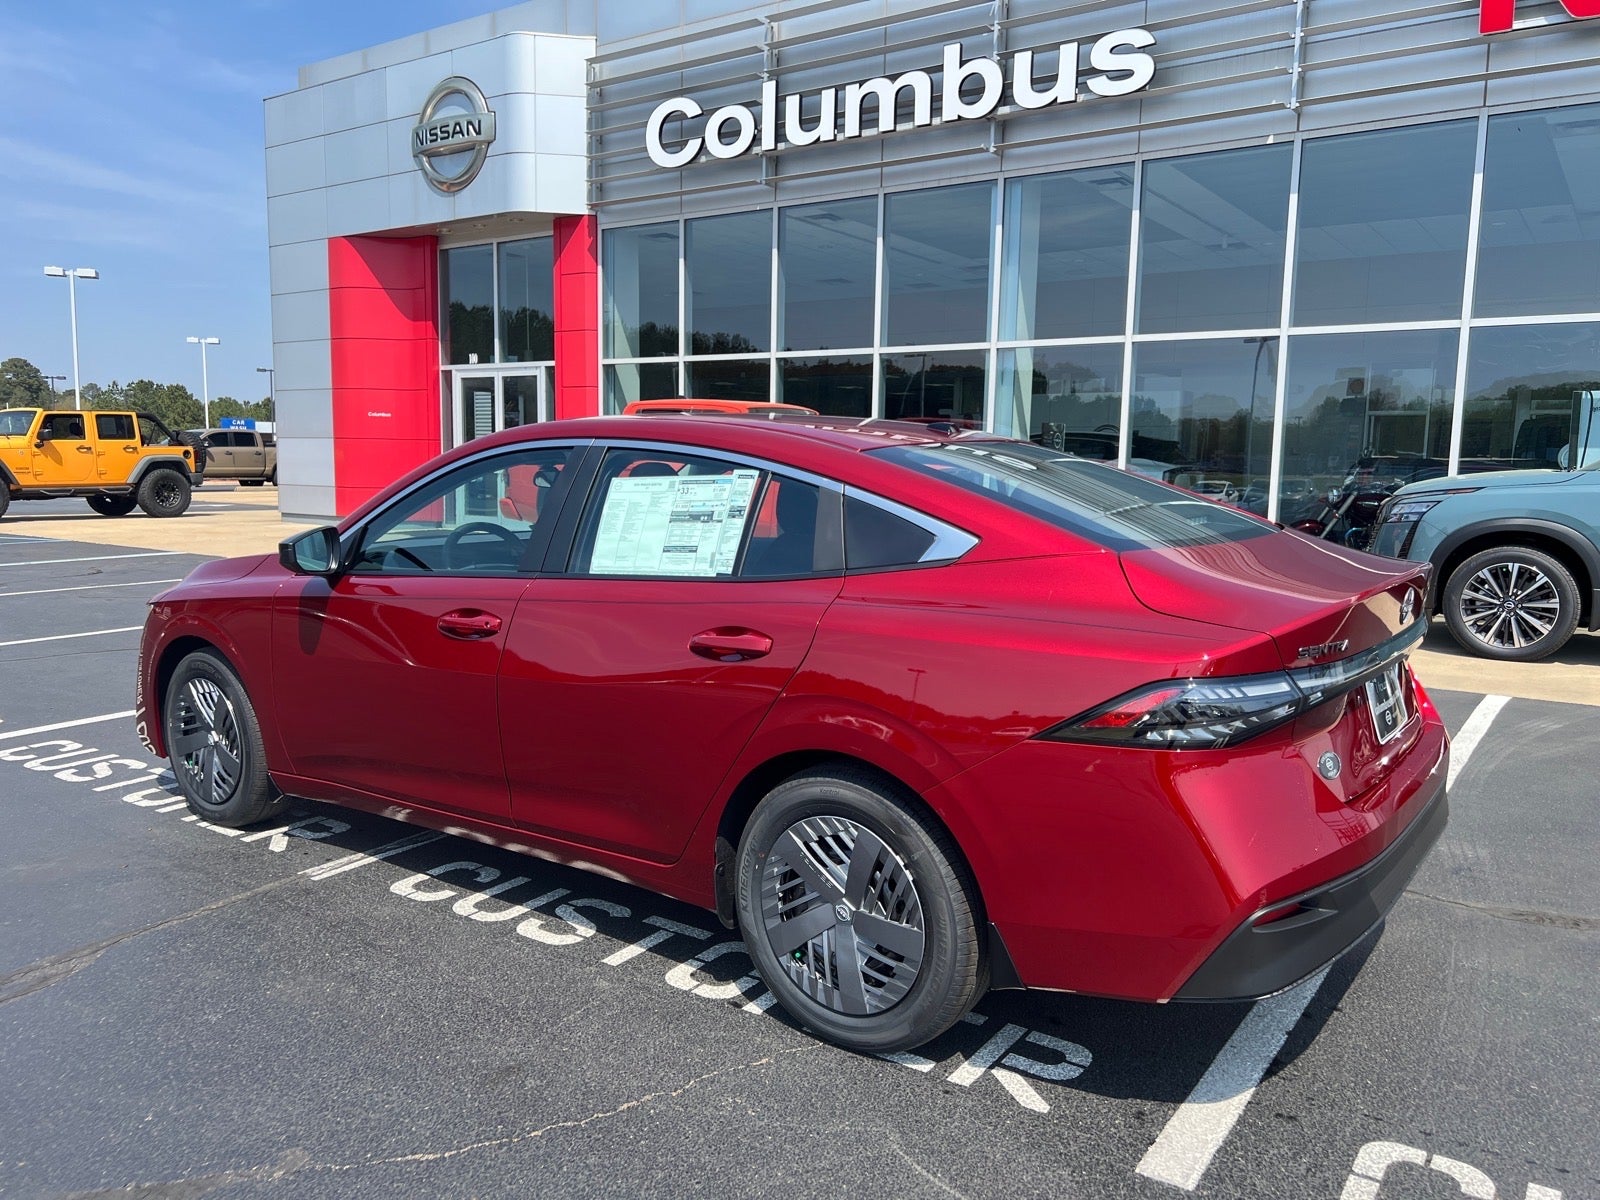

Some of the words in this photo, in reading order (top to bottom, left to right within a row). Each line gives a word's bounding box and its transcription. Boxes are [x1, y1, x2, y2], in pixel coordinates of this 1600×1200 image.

[415, 119, 482, 147] NISSAN
[645, 27, 1157, 169] Columbus
[739, 847, 753, 914] KINERGY
[389, 860, 1093, 1114] CUSTOR
